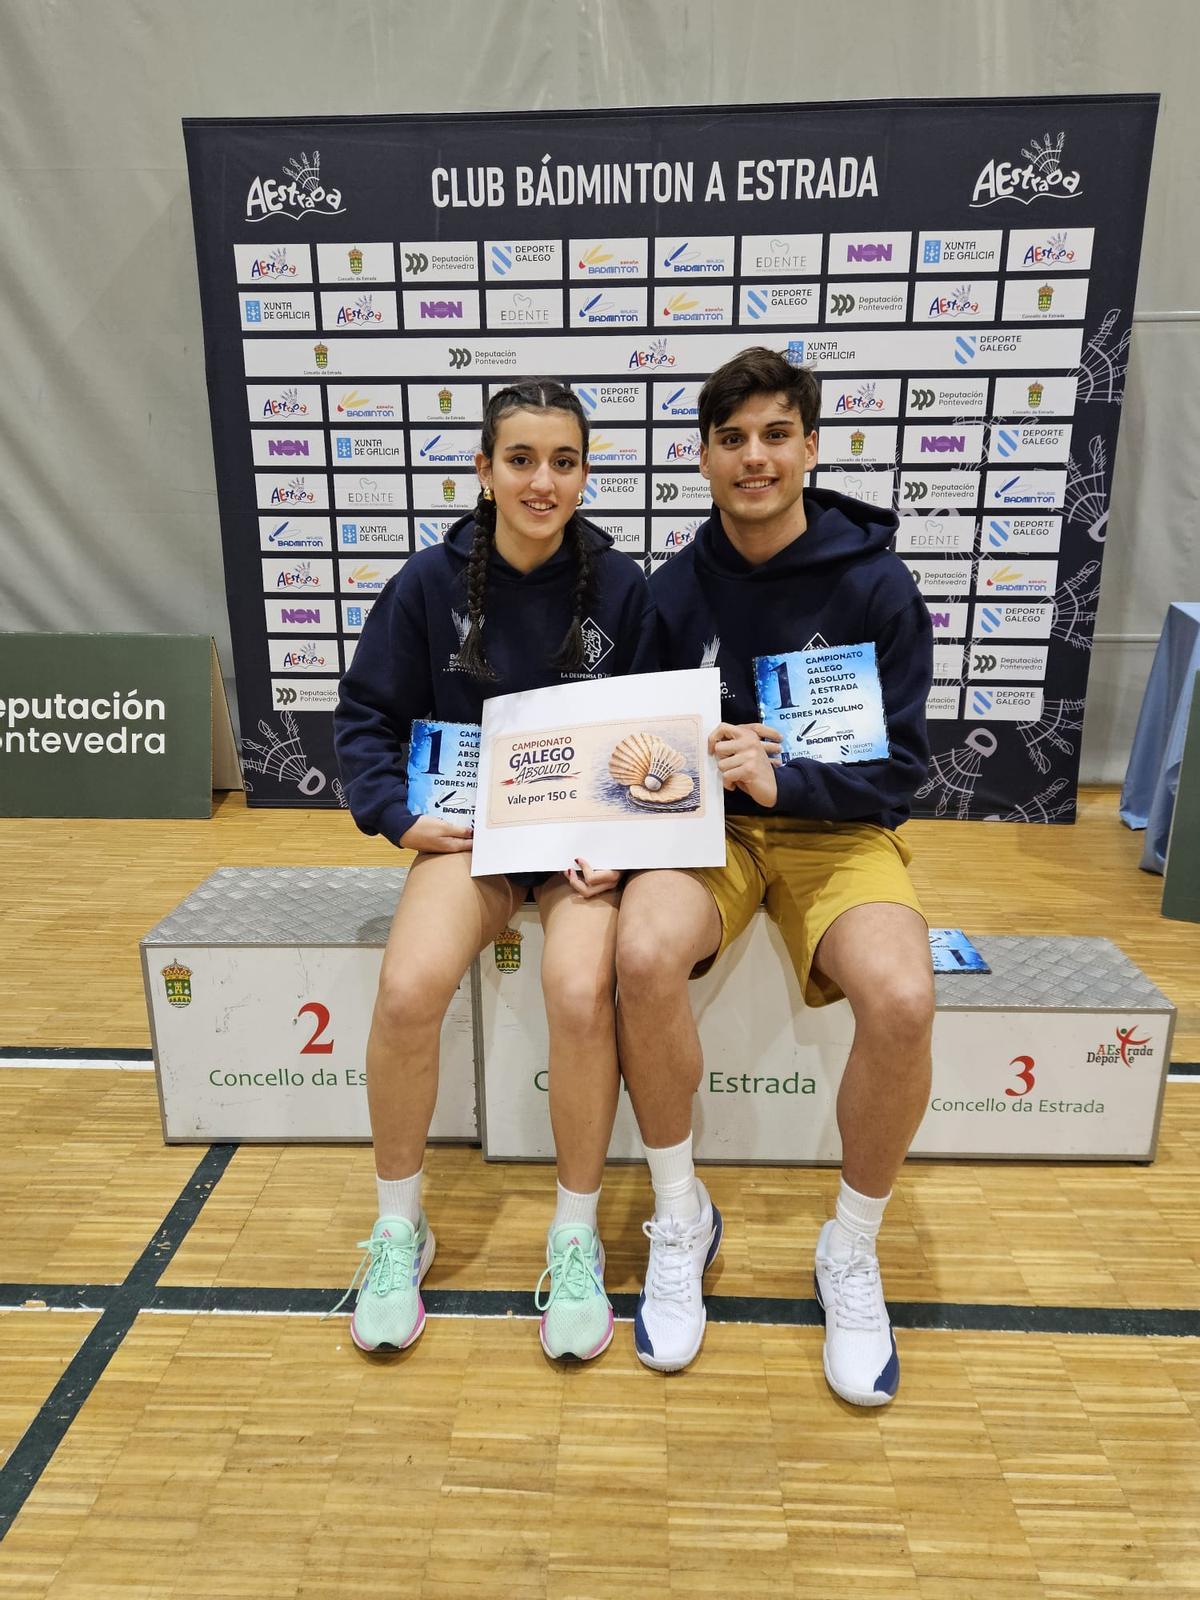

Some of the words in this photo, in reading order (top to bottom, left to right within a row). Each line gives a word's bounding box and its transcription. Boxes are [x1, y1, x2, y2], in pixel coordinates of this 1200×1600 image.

[431, 167, 504, 208] CLUB
[516, 153, 693, 207] BÁDMINTON
[705, 161, 725, 202] A
[737, 155, 878, 201] ESTRADA
[847, 244, 892, 262] NON
[944, 252, 954, 260] DE
[957, 251, 995, 259] GALICIA
[432, 255, 474, 263] Deputación
[756, 256, 806, 268] EDENTE
[432, 262, 474, 270] Pontevedra
[772, 289, 812, 297] DEPORTE
[859, 295, 903, 304] Deputación
[264, 302, 292, 310] XUNTA
[420, 302, 462, 318] NON
[859, 303, 902, 311] Pontevedra
[277, 311, 310, 319] GALICIA
[501, 309, 549, 320] EDENTE
[980, 335, 1021, 343] DEPORTE
[808, 342, 837, 350] XUNTA
[475, 350, 517, 359] Deputación
[819, 351, 855, 359] GALICIA
[475, 357, 517, 365] Pontevedra
[939, 391, 983, 399] Deputación
[268, 440, 309, 456] NON
[355, 439, 382, 447] XUNTA
[921, 436, 965, 452] NON
[931, 484, 975, 492] Deputación
[349, 493, 393, 502] EDENTE
[911, 536, 959, 545] EDENTE
[281, 609, 320, 623] NON
[806, 651, 863, 664] CAMPIONATO
[807, 664, 842, 674] GALEGO
[809, 673, 856, 685] ABSOLUTO
[768, 661, 800, 711] 1
[818, 683, 858, 694] ESTRADA
[812, 697, 834, 705] 2026
[0, 689, 165, 728] putación
[815, 704, 863, 716] MASCULINO
[0, 727, 165, 754] ntevedra
[512, 736, 572, 751] CAMPIONATO
[421, 730, 445, 775] 1
[509, 747, 575, 771] GALEGO
[515, 762, 570, 782] ABSOLUTO
[434, 779, 465, 787] DOBRES
[508, 795, 526, 805] Vale
[529, 794, 545, 805] por
[547, 791, 566, 801] 150
[569, 790, 577, 799] €
[443, 807, 476, 815] BADMINT
[298, 1002, 334, 1054] 2
[209, 1068, 304, 1088] Concello
[312, 1069, 337, 1086] da
[1005, 1055, 1035, 1096] 3
[710, 1072, 816, 1094] Estrada
[931, 1098, 1006, 1112] Concello
[1012, 1099, 1033, 1112] da
[1039, 1099, 1105, 1113] Estrada
